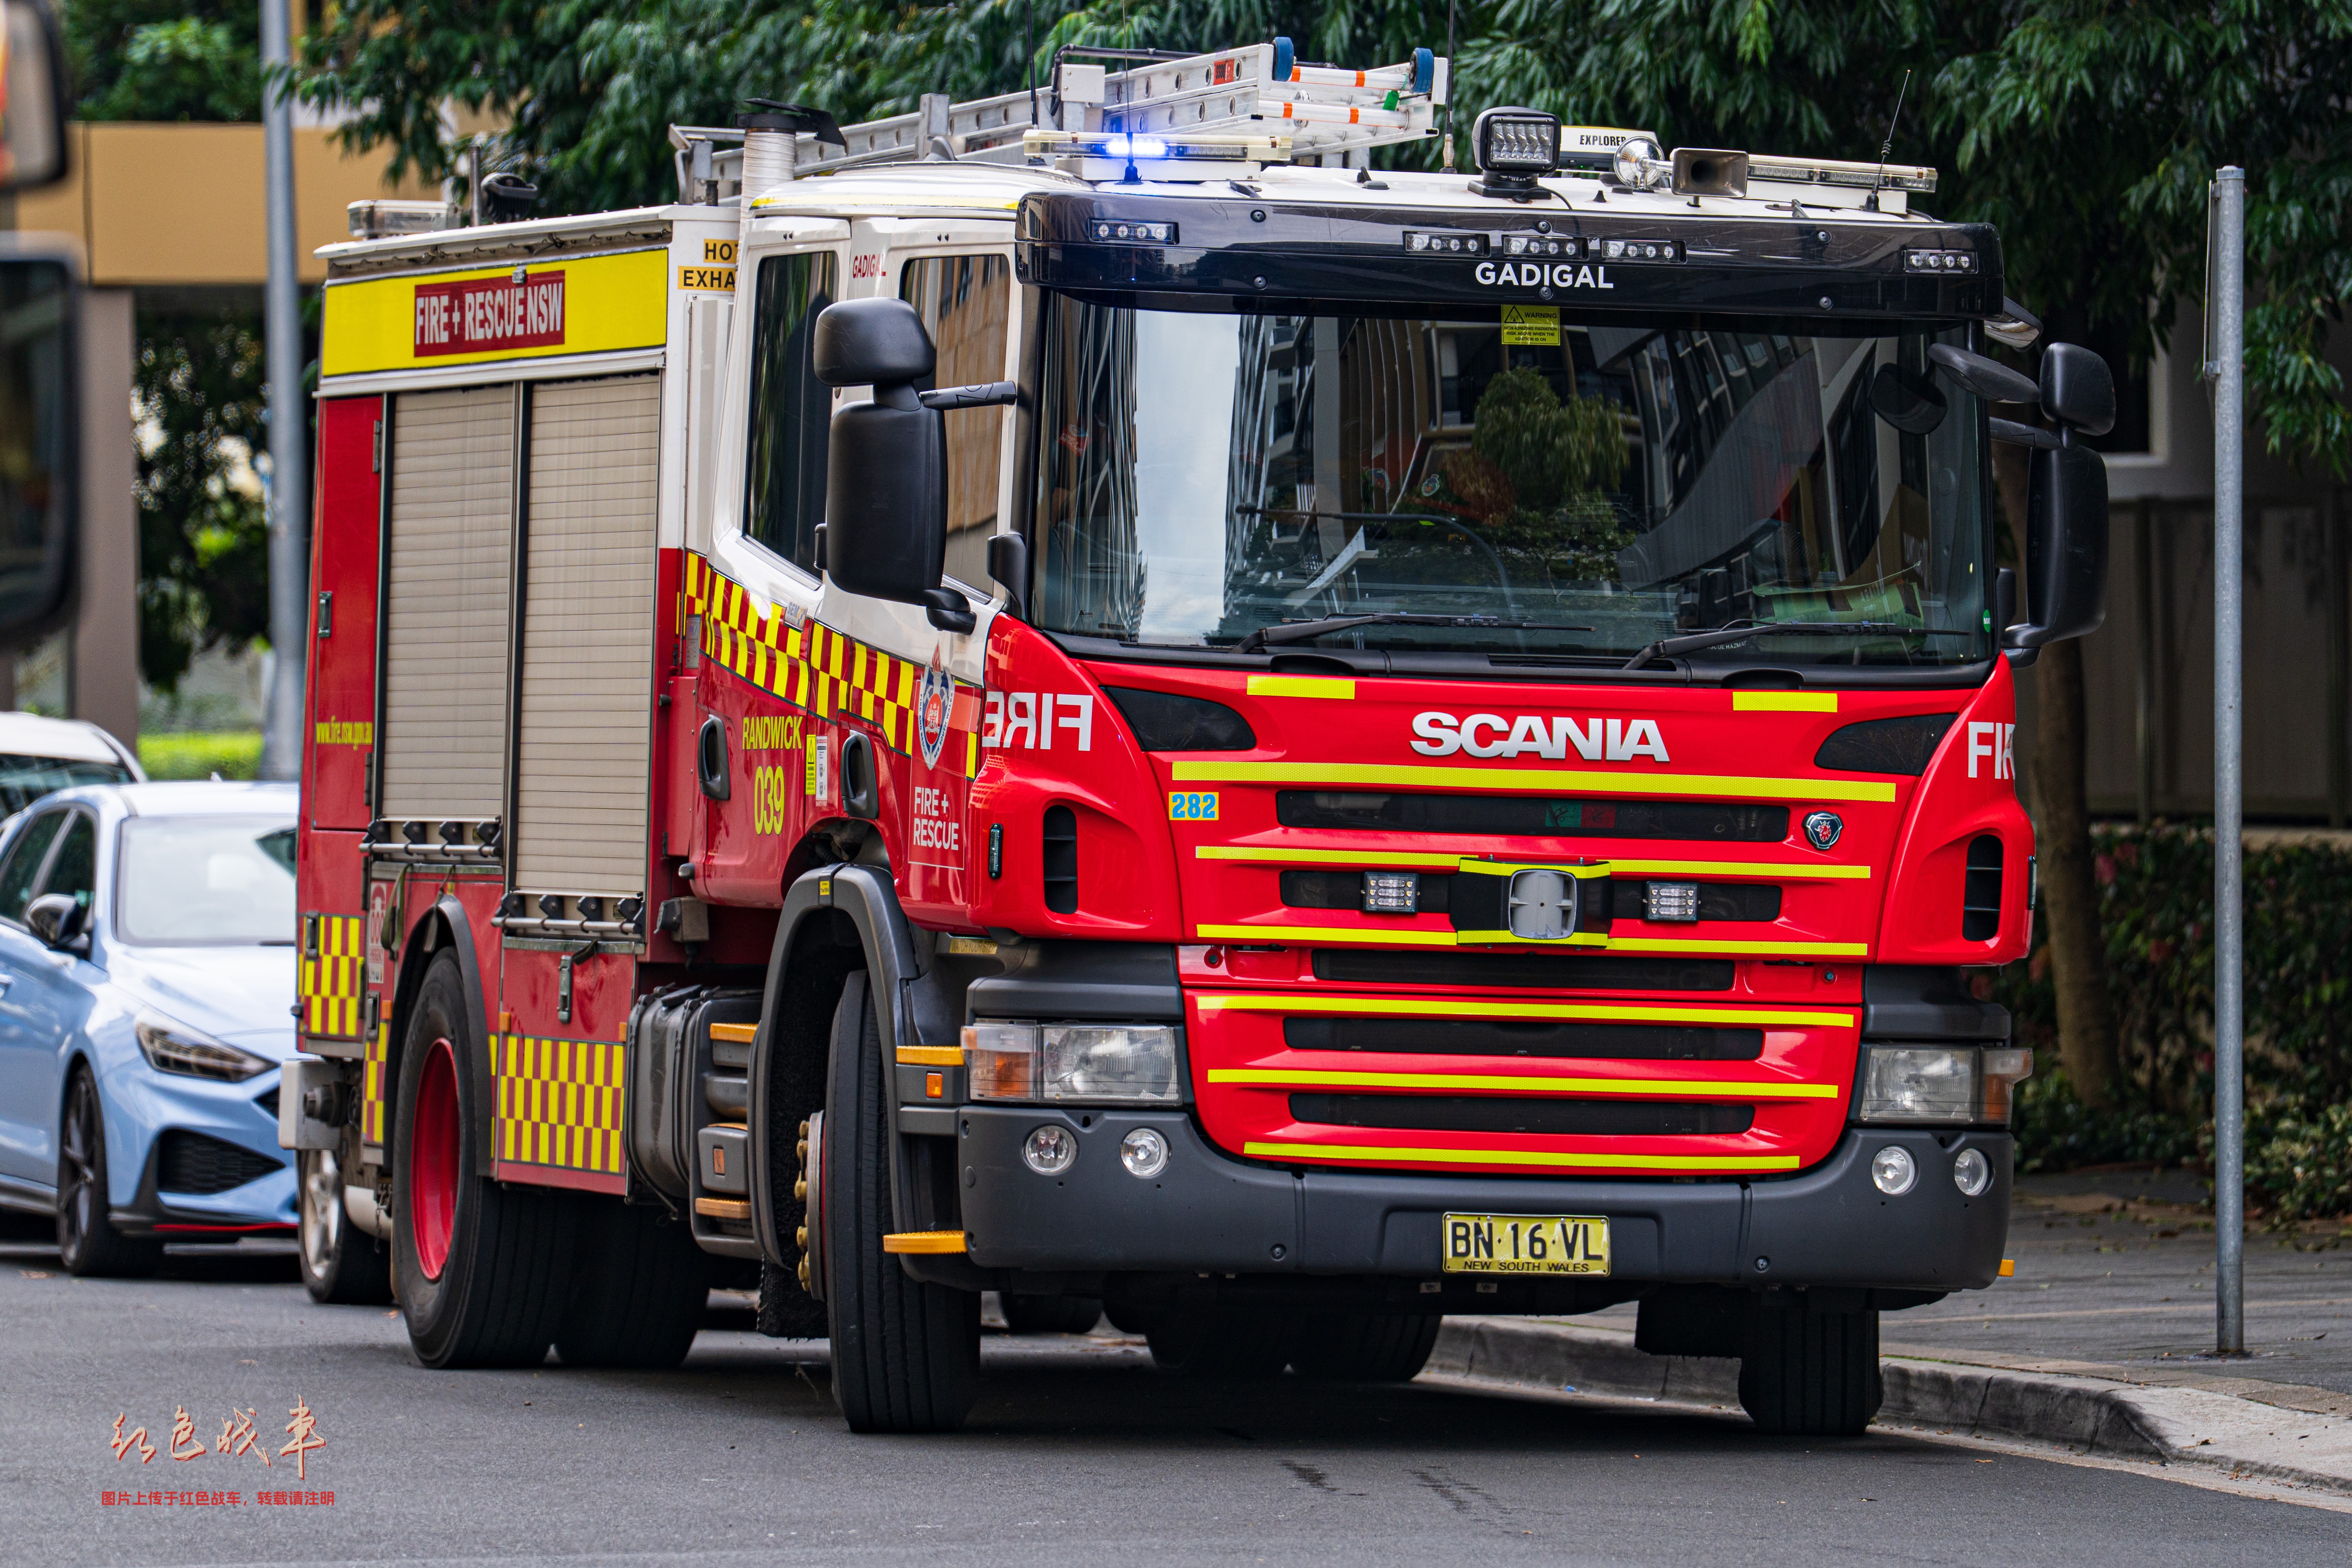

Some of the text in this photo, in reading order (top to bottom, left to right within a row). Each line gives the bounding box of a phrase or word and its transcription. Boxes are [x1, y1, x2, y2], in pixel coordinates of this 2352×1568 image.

[853, 254, 886, 279] GADIGAL
[1476, 262, 1614, 288] GADIGAL
[416, 295, 449, 344] FIRE
[465, 287, 525, 340] RESCUE
[527, 282, 563, 334] NSW
[1726, 640, 1747, 649] HAZMAT
[742, 715, 803, 750] RANDWICK
[1409, 711, 1670, 762] SCANIA
[754, 765, 785, 835] 039
[914, 786, 939, 816] FIRE
[1172, 793, 1216, 818] 282
[913, 818, 959, 850] RESCUE
[1464, 1261, 1589, 1272] NEW SOUTH WALES
